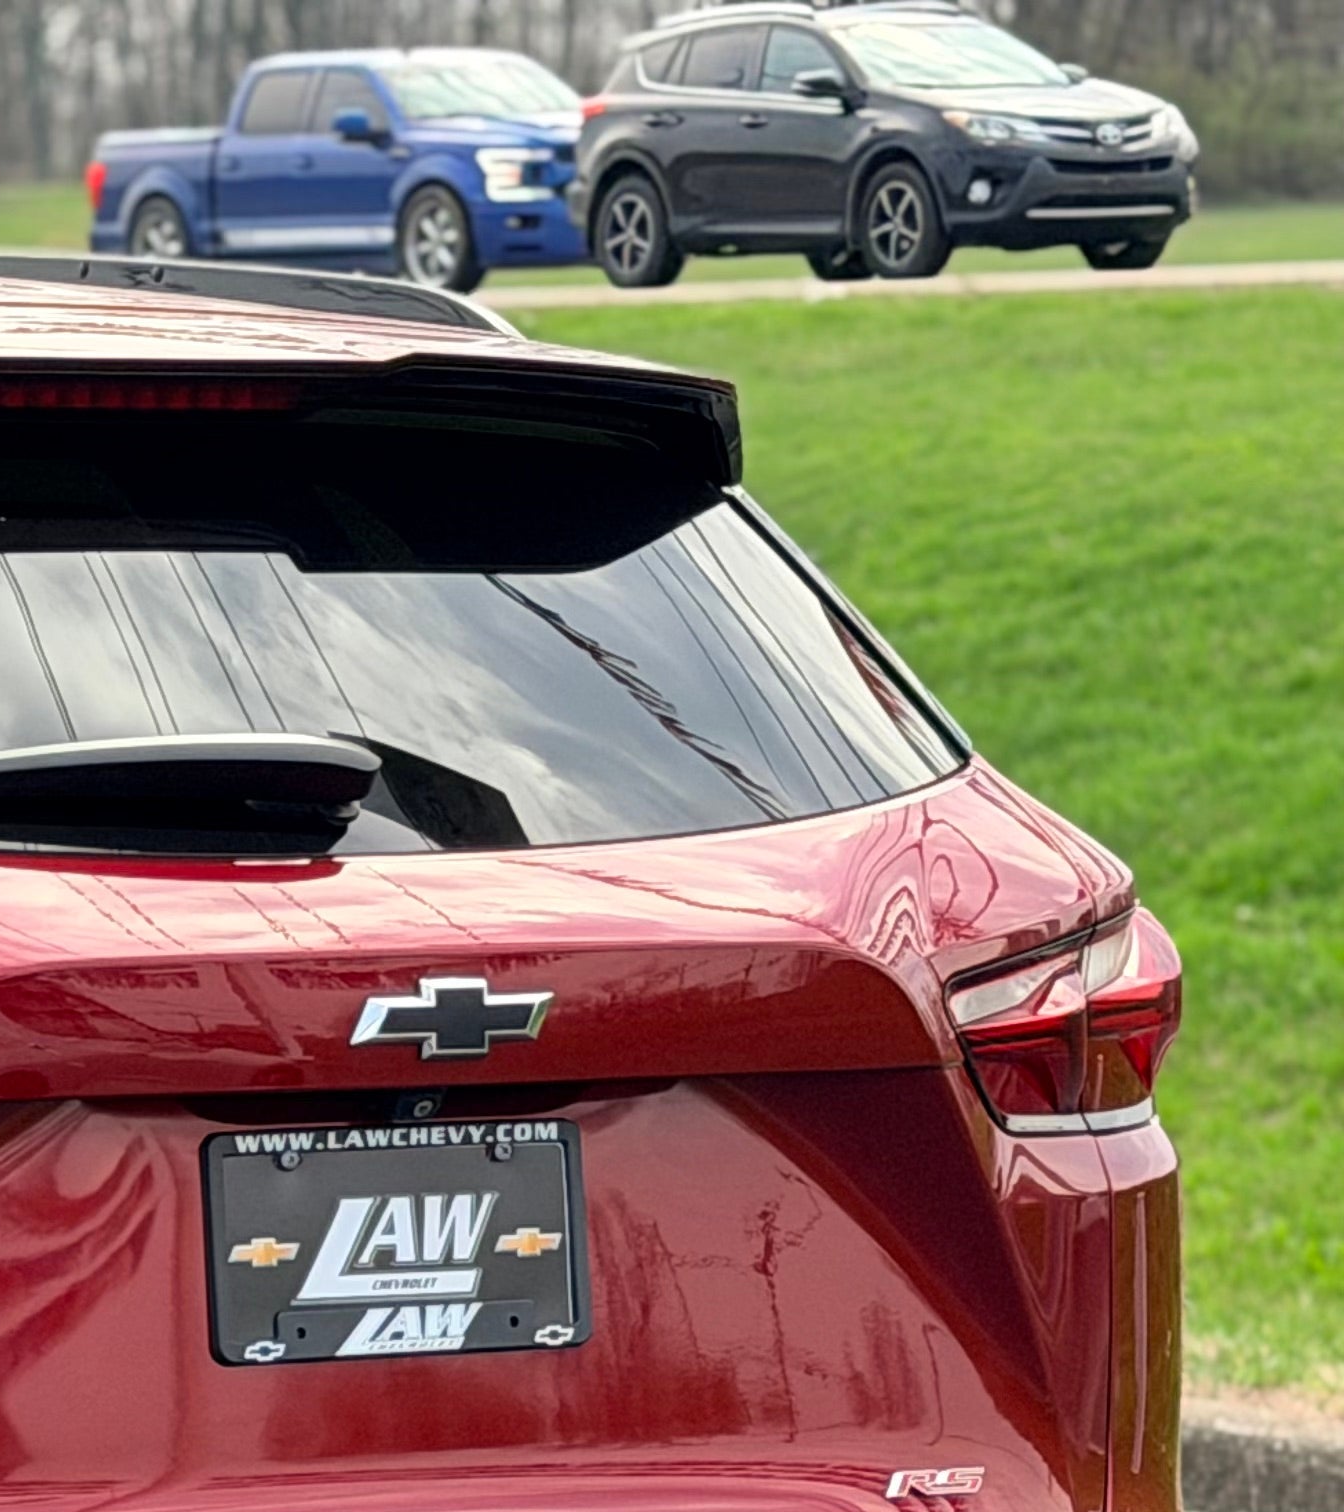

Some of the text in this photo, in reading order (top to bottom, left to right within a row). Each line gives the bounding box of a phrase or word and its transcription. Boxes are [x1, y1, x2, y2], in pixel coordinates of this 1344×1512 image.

[234, 1122, 559, 1153] WWW.LAWCHEVY.COM
[294, 1192, 498, 1303] LAW
[334, 1302, 483, 1357] LAW
[885, 1465, 986, 1499] RS
